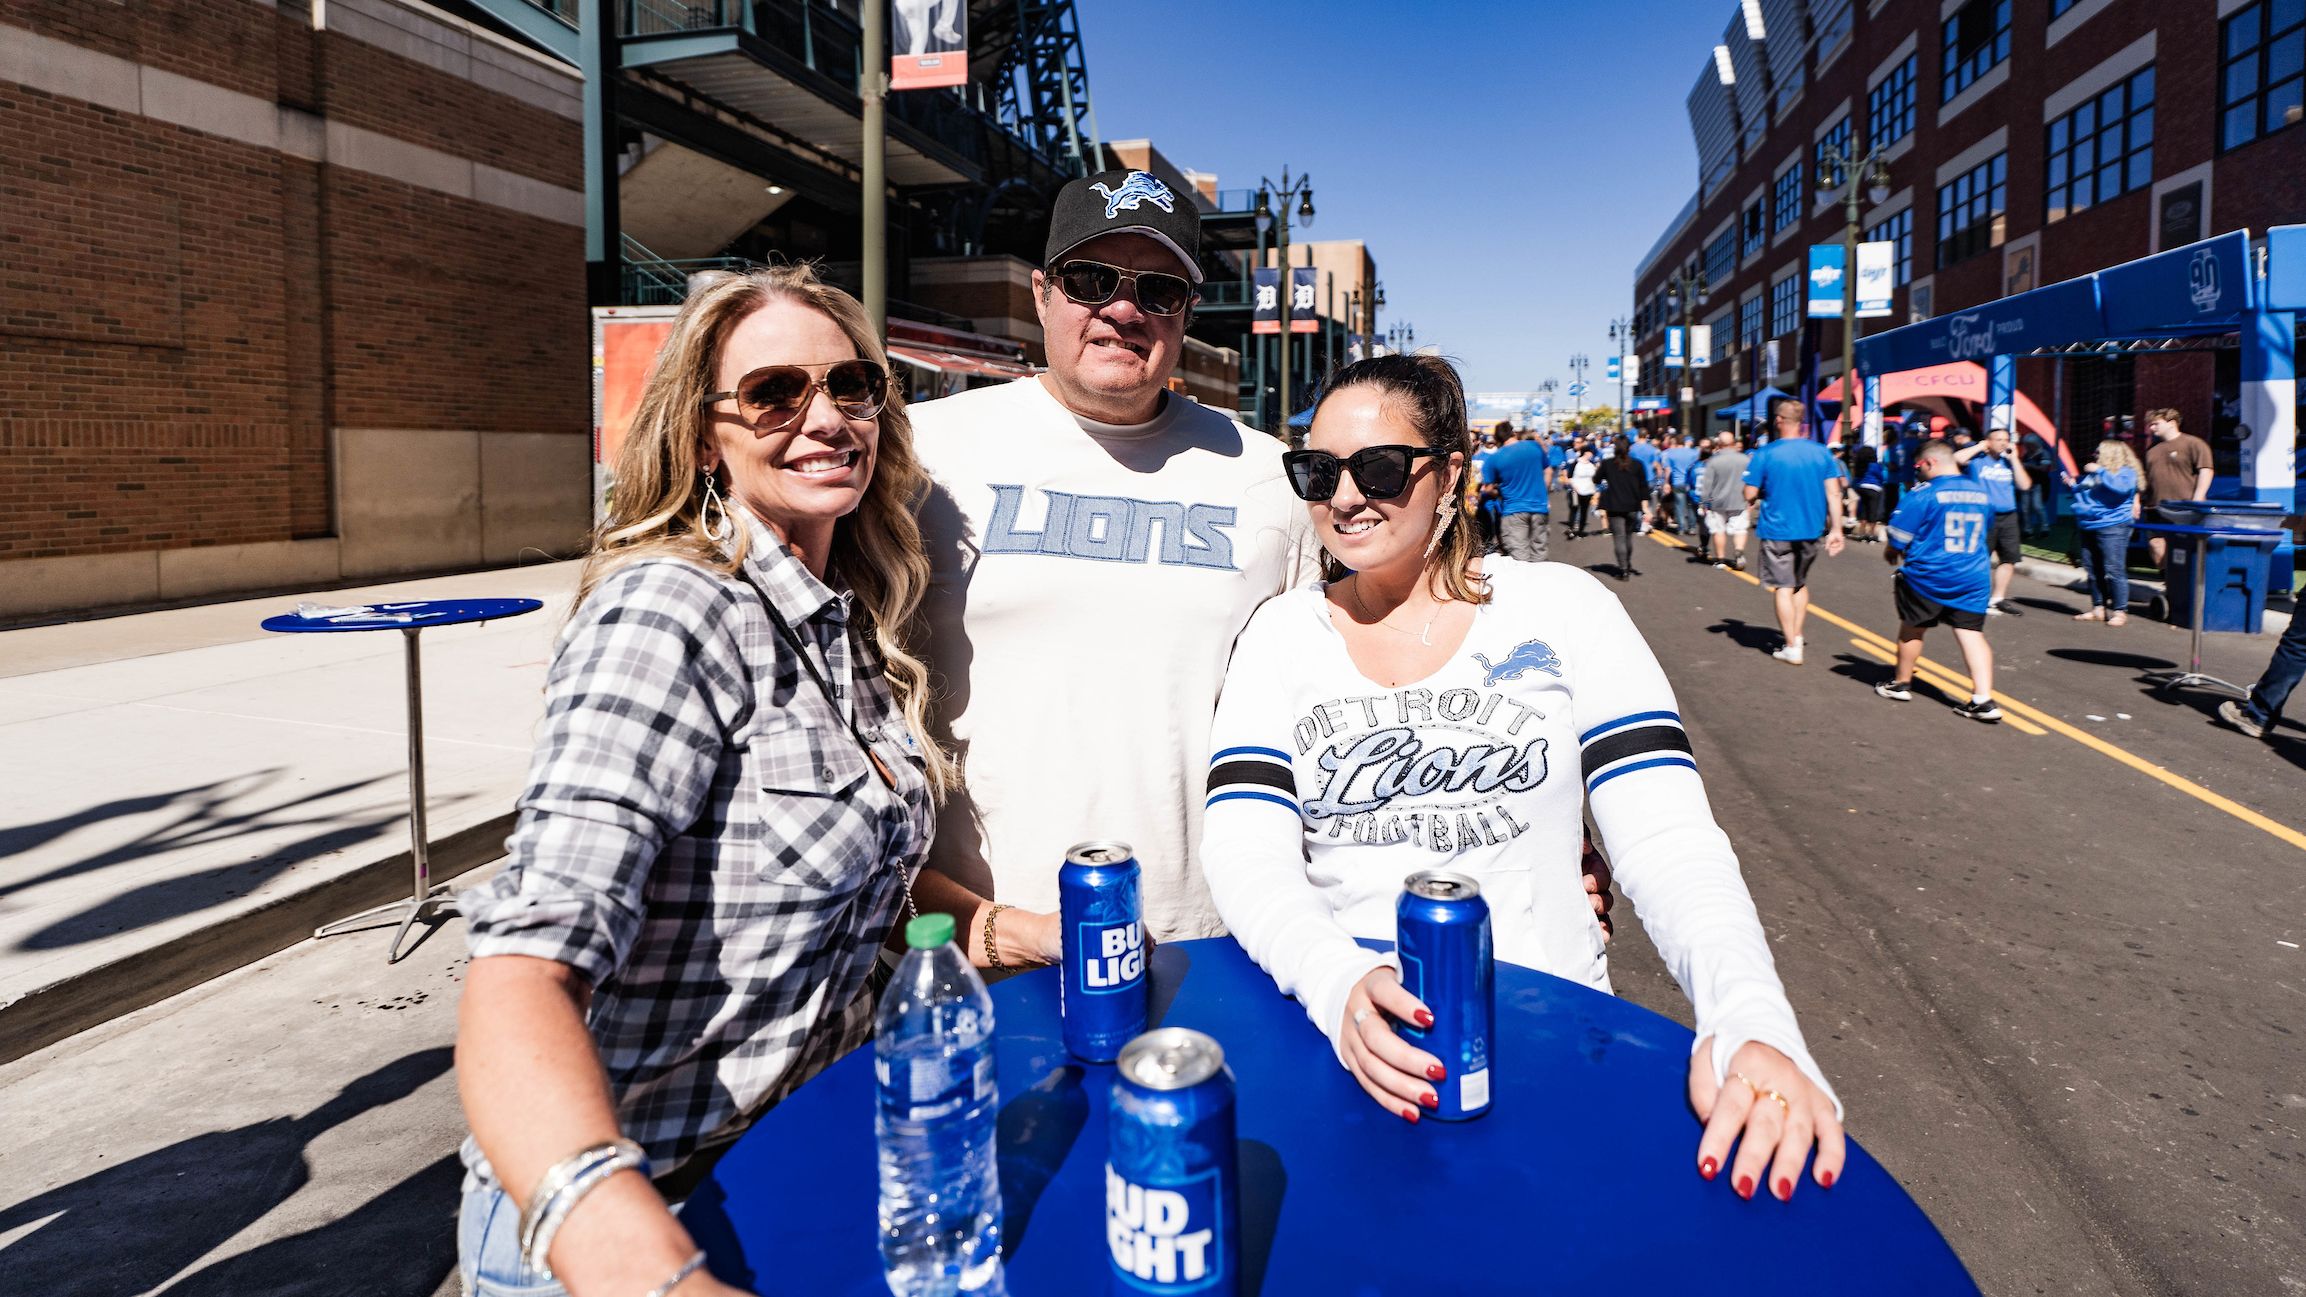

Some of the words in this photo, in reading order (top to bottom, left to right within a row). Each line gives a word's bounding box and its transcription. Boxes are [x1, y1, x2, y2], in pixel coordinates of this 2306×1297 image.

[1256, 284, 1277, 312] D
[1293, 283, 1315, 311] D
[1948, 313, 1996, 359] Ford
[1915, 374, 1975, 386] CFCU
[1944, 511, 1985, 553] 97
[1293, 688, 1546, 756] DETROIT
[1303, 726, 1549, 820] Lions
[1328, 805, 1531, 853] FOOTBALL
[1101, 921, 1144, 959] BU
[1106, 1216, 1213, 1284] GHT
